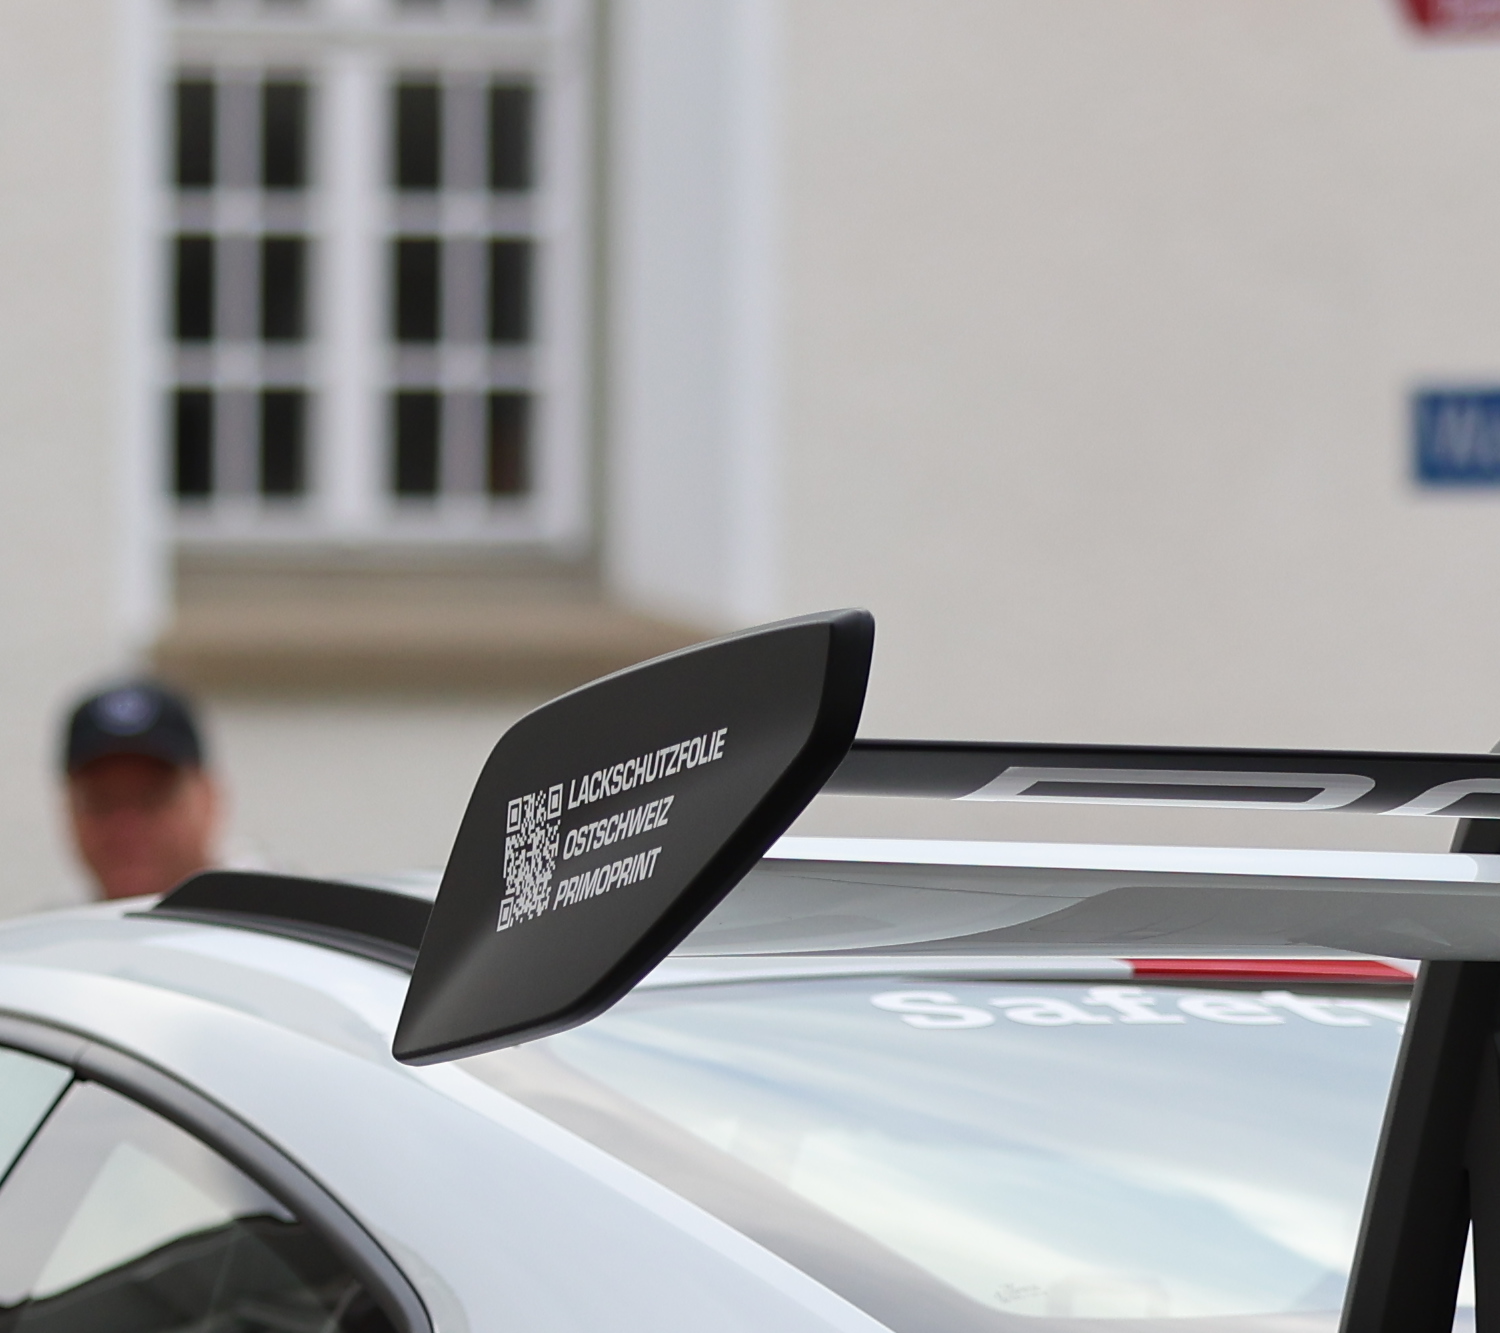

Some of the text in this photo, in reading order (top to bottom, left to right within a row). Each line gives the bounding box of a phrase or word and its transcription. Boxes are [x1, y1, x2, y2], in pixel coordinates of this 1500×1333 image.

[567, 728, 728, 809] LACKSCHUTZFOLIE
[562, 796, 675, 861] OSTSCHWEIZ
[552, 847, 662, 911] PRIMOPRINT
